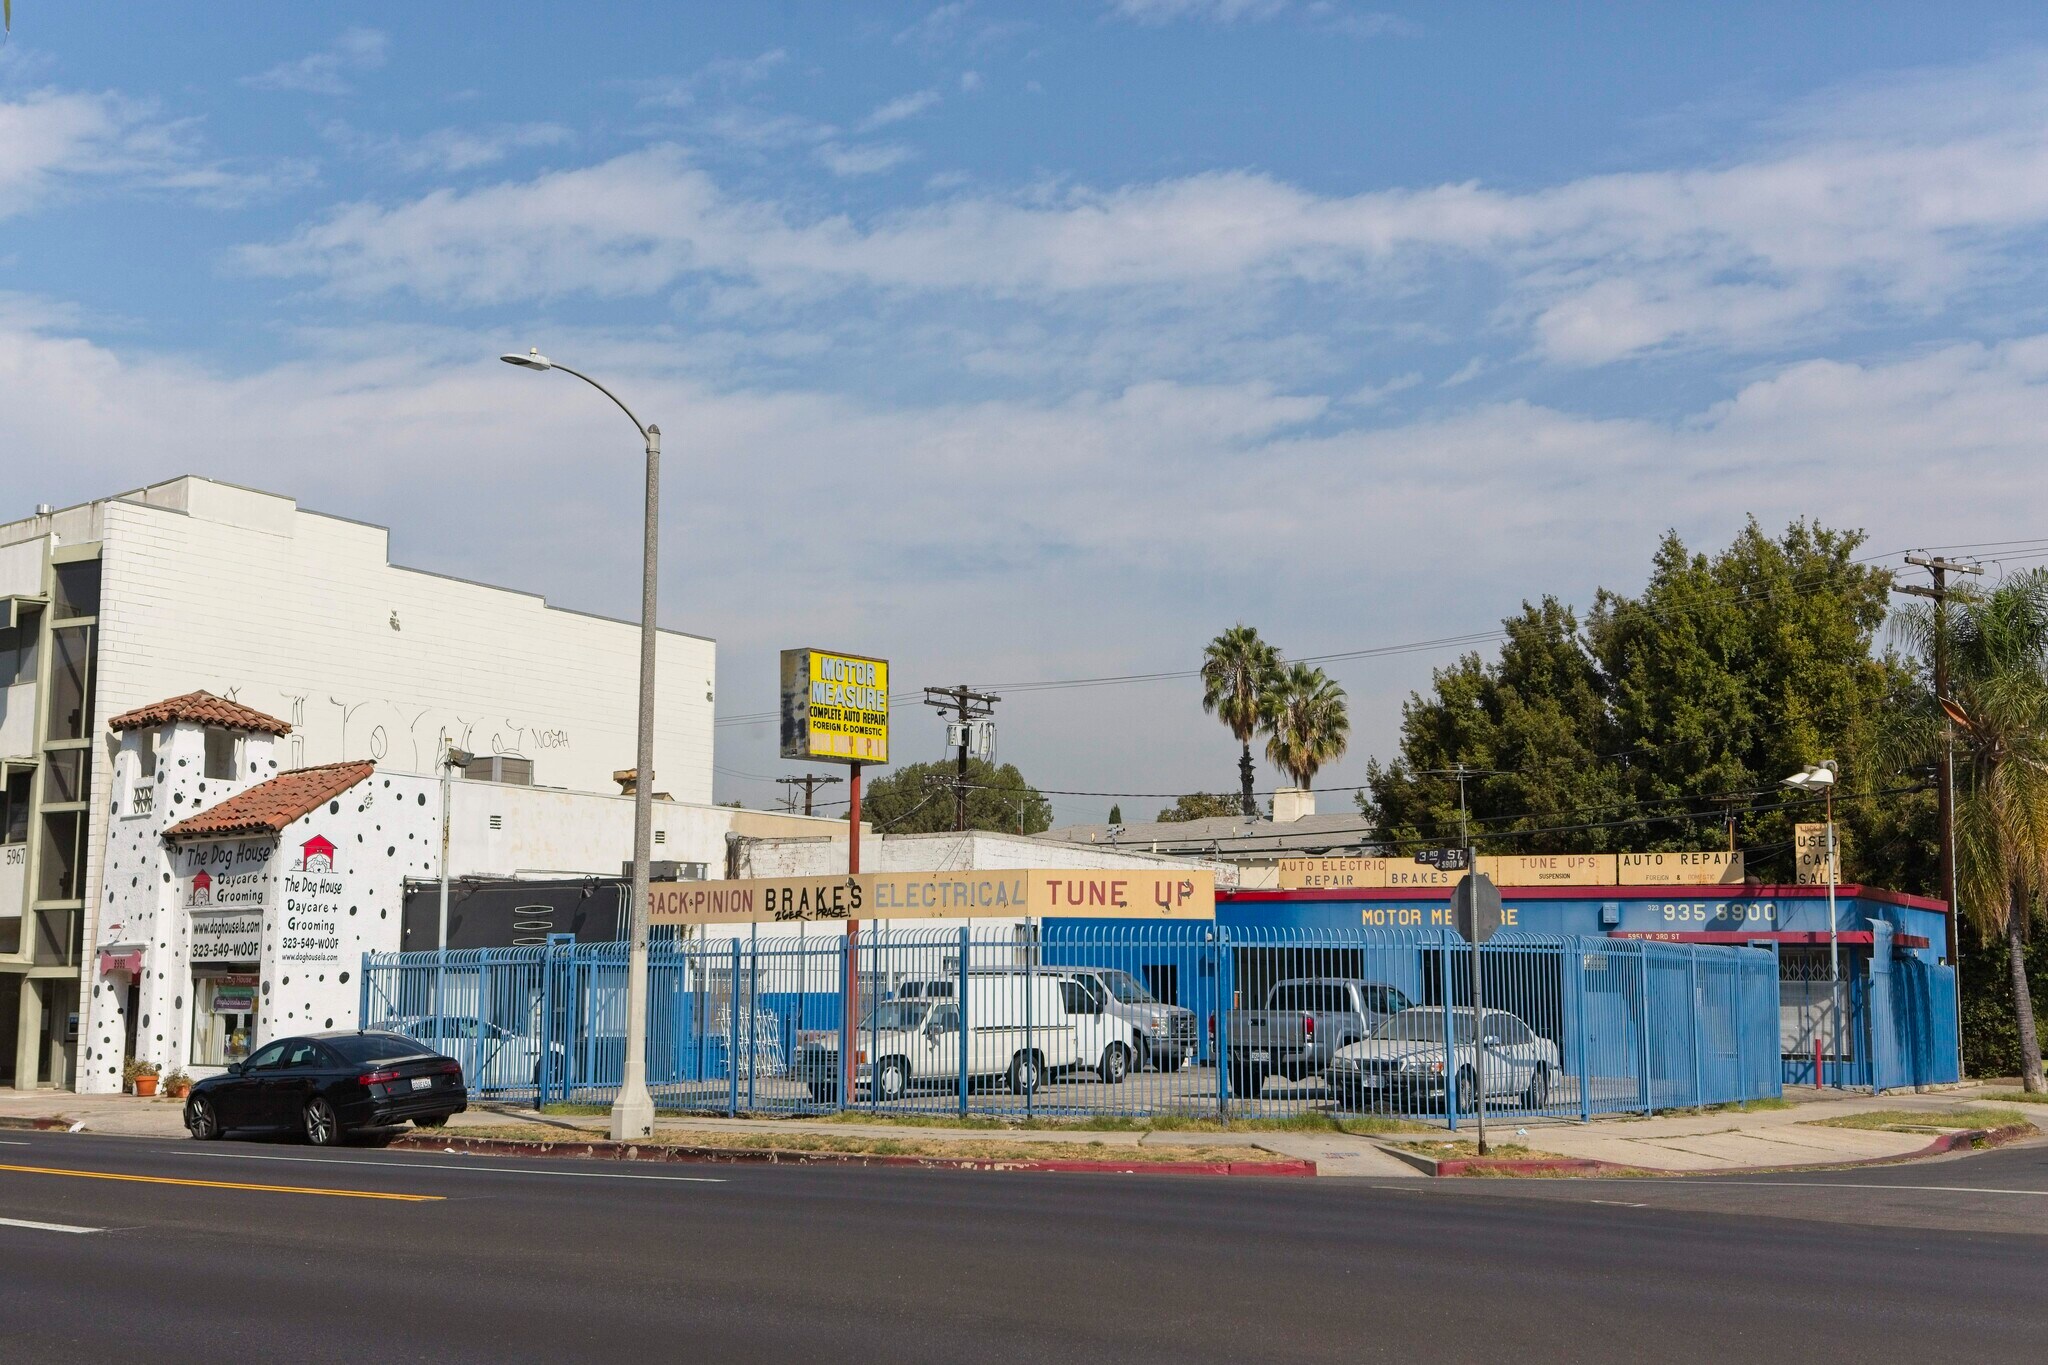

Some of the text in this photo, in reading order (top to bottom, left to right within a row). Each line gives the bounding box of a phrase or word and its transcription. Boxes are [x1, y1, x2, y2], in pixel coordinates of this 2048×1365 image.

[821, 657, 875, 687] MOTOR
[811, 681, 885, 712] MEASURE
[810, 706, 886, 726] COMPLETE AUTO REPAIR
[813, 721, 882, 736] FOREIGN & DOMESTIC
[7, 848, 26, 866] 5967
[188, 843, 271, 870] The Dog House
[1520, 857, 1596, 869] TUNE UPS
[1623, 852, 1740, 866] AUTO REPAIR
[1281, 859, 1385, 872] AUTO ELECTRIC
[217, 872, 258, 888] Daycare
[1305, 875, 1354, 886] REPAIR
[1392, 872, 1448, 884] BRAKES
[1799, 873, 1839, 885] SALE
[285, 875, 343, 898] The Dog House
[875, 880, 1026, 908] ELECTRICAL
[1046, 880, 1195, 907] TUNE UP
[217, 889, 263, 904] Grooming
[766, 885, 862, 911] BRAKES
[287, 899, 329, 915] Daycare
[1663, 903, 1706, 921] 935
[1715, 903, 1777, 921] 8900
[1362, 909, 1421, 926] MOTOR
[193, 917, 260, 939] www.doghousela.com
[288, 917, 335, 935] Grooming
[192, 942, 259, 958] 323-549-WOOF
[282, 937, 339, 949] 323-549-WOOF
[282, 952, 338, 963] www.doghousela.com
